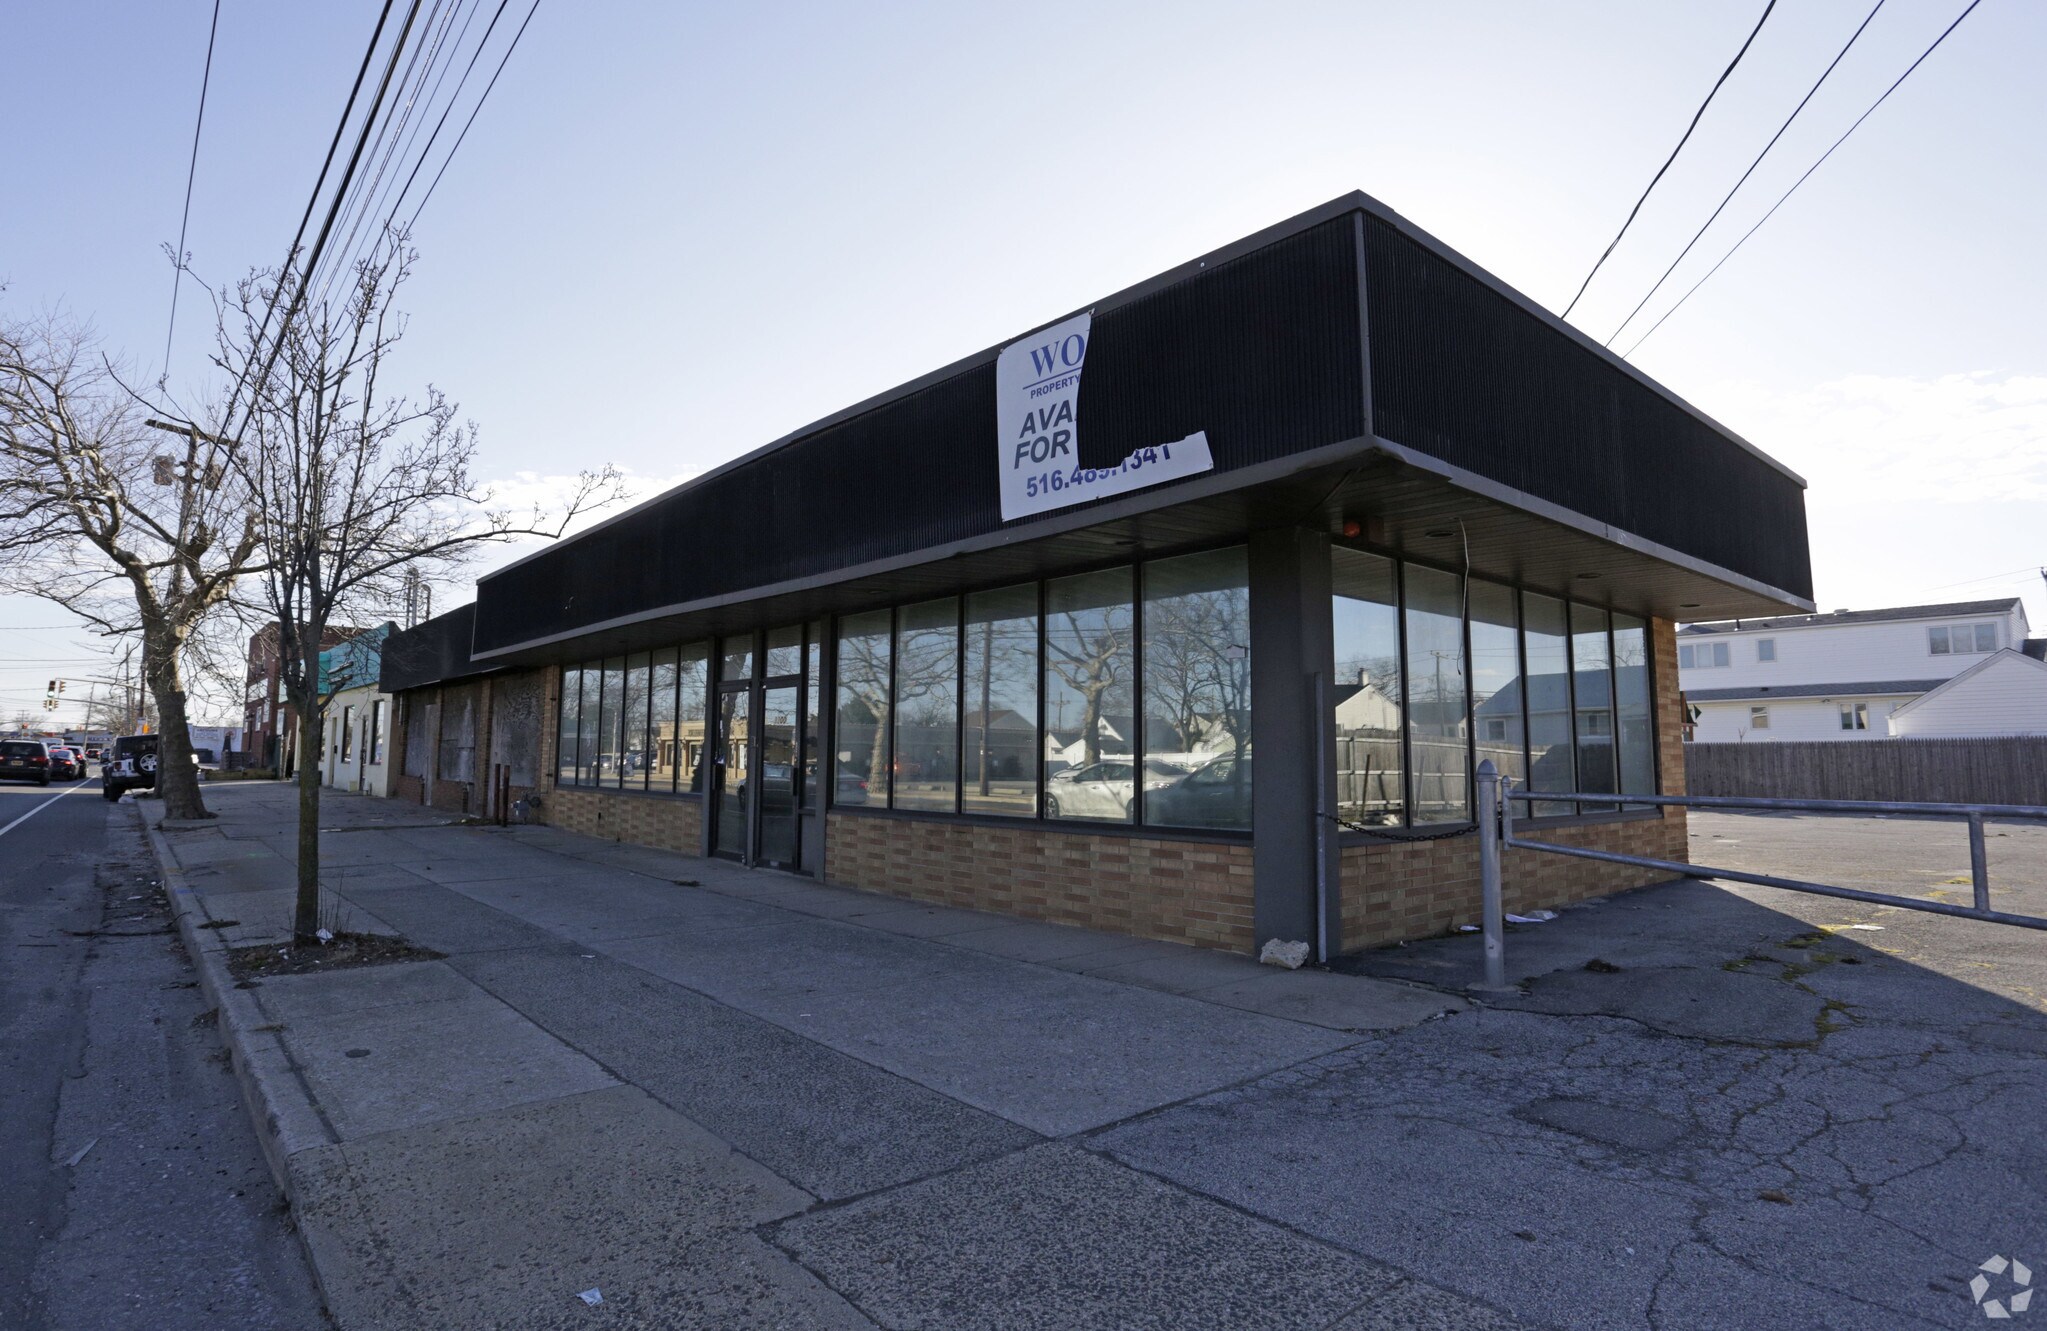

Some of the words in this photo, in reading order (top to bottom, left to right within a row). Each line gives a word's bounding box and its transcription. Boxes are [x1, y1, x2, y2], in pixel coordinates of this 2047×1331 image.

[1030, 334, 1085, 377] WO
[1030, 374, 1081, 399] PROPERTY
[1019, 400, 1076, 438] AVA
[1014, 430, 1071, 469] FOR
